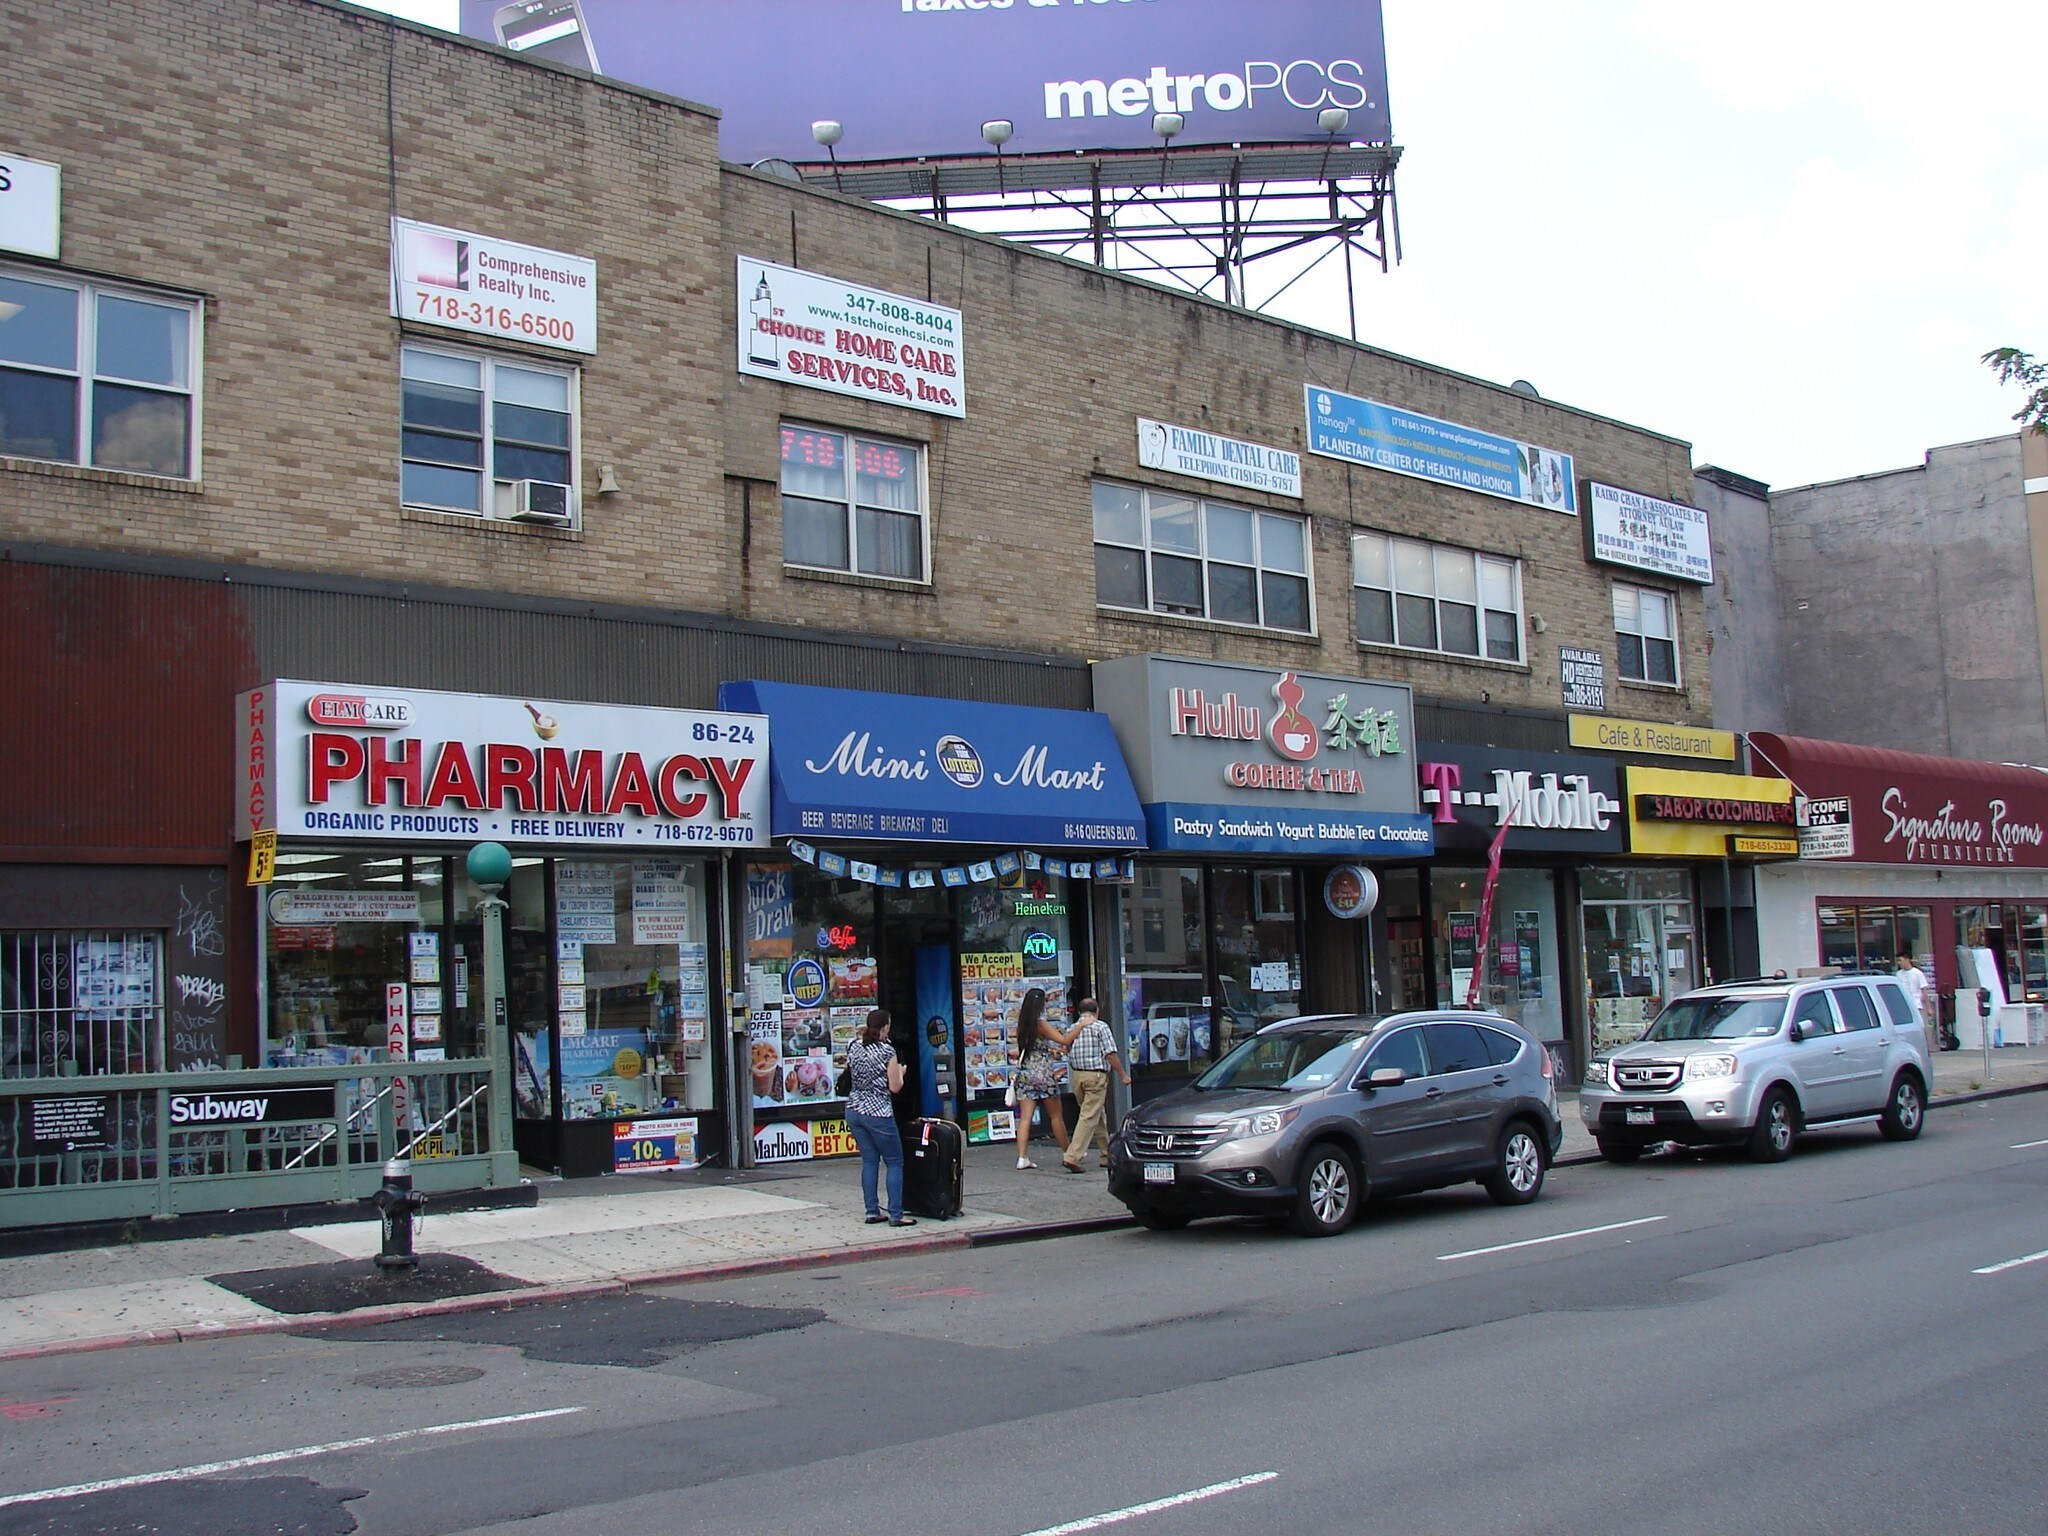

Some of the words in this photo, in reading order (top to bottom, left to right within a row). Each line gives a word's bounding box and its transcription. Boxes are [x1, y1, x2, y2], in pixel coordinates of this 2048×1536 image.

[478, 251, 587, 289] Comprehensive
[478, 273, 524, 300] Realty
[528, 284, 556, 304] Inc.
[416, 291, 574, 342] 718-316-6500
[772, 306, 785, 317] ST
[845, 292, 954, 334] 347-808-8404
[807, 304, 954, 349] www.1stchoicehcsi.com
[758, 317, 826, 347] CHOICE
[835, 328, 898, 365] HOME
[900, 343, 957, 378] CARE
[787, 349, 913, 401] SERVICES,
[916, 377, 958, 407] Inc.
[1317, 415, 1348, 433] nanogy
[1171, 427, 1217, 459] FAMILY
[1221, 439, 1265, 470] DENTAL
[1267, 450, 1299, 477] CARE
[1177, 454, 1230, 479] TELEPHONE
[1319, 435, 1375, 461] PLANETARY
[1376, 449, 1413, 470] CENTER
[1413, 458, 1425, 473] OF
[1426, 461, 1460, 481] HEALTH
[1462, 469, 1481, 486] AND
[1481, 475, 1513, 494] HONOR
[1620, 493, 1641, 508] CHAN
[1642, 499, 1648, 510] &
[1619, 506, 1656, 525] ATTORNEY
[1669, 517, 1684, 532] LAW
[1561, 649, 1601, 664] AVAILABLE
[1562, 661, 1575, 684] HD
[320, 701, 408, 721] ELMCARE
[1169, 687, 1260, 741] Hulu
[692, 723, 755, 744] 86-24
[1598, 723, 1629, 746] Cafe
[1633, 728, 1642, 747] &
[1646, 728, 1712, 754] Restaurant
[249, 692, 264, 831] PHARMACY
[805, 731, 930, 781] Mini
[993, 745, 1106, 791] Mart
[942, 757, 979, 774] LOTTERY
[308, 732, 756, 819] PHARMACY
[1226, 762, 1305, 791] COFFEE
[1306, 766, 1325, 792] &
[1327, 768, 1366, 794] TEA
[1655, 797, 1703, 820] SABOR
[1810, 814, 1837, 826] TAX
[305, 811, 384, 832] ORGANIC
[390, 814, 479, 834] PRODUCTS
[511, 819, 550, 836] FREE
[555, 820, 625, 838] DELIVERY
[654, 824, 754, 842] 718-672-9670
[802, 811, 825, 829] BEER
[831, 812, 874, 831] BEVERAGE
[880, 815, 926, 833] BREAKFAST
[931, 817, 949, 834] DELI
[1064, 823, 1084, 839] 86-16
[1085, 824, 1116, 840] QUEENS
[1116, 826, 1138, 841] BLVD.
[1174, 818, 1213, 838] Pastry
[1218, 818, 1273, 838] Sandwich
[1276, 821, 1315, 841] Yogurt
[1318, 823, 1355, 840] Bubble
[1355, 825, 1376, 841] Tea
[1379, 825, 1429, 842] Chocolate
[1881, 787, 1982, 861] Signature
[1988, 799, 2043, 853] Rooms
[1740, 840, 1792, 851] 718-651-3330
[1919, 843, 2014, 862] FURNITURE
[577, 886, 612, 895] DOCUMENTS
[1014, 902, 1067, 916] Heineken
[1453, 926, 1476, 938] FAST
[1023, 938, 1056, 954] ATM
[965, 955, 979, 964] We
[982, 954, 1014, 966] Accept
[1500, 954, 1517, 963] FREE
[961, 965, 984, 978] EBT
[987, 964, 1022, 978] Cards
[1253, 970, 1261, 983] A
[751, 1021, 779, 1031] OFFEE
[171, 1095, 268, 1122] Subway
[820, 1121, 836, 1134] We
[754, 1132, 809, 1160] Marlboro
[814, 1134, 841, 1155] EBT
